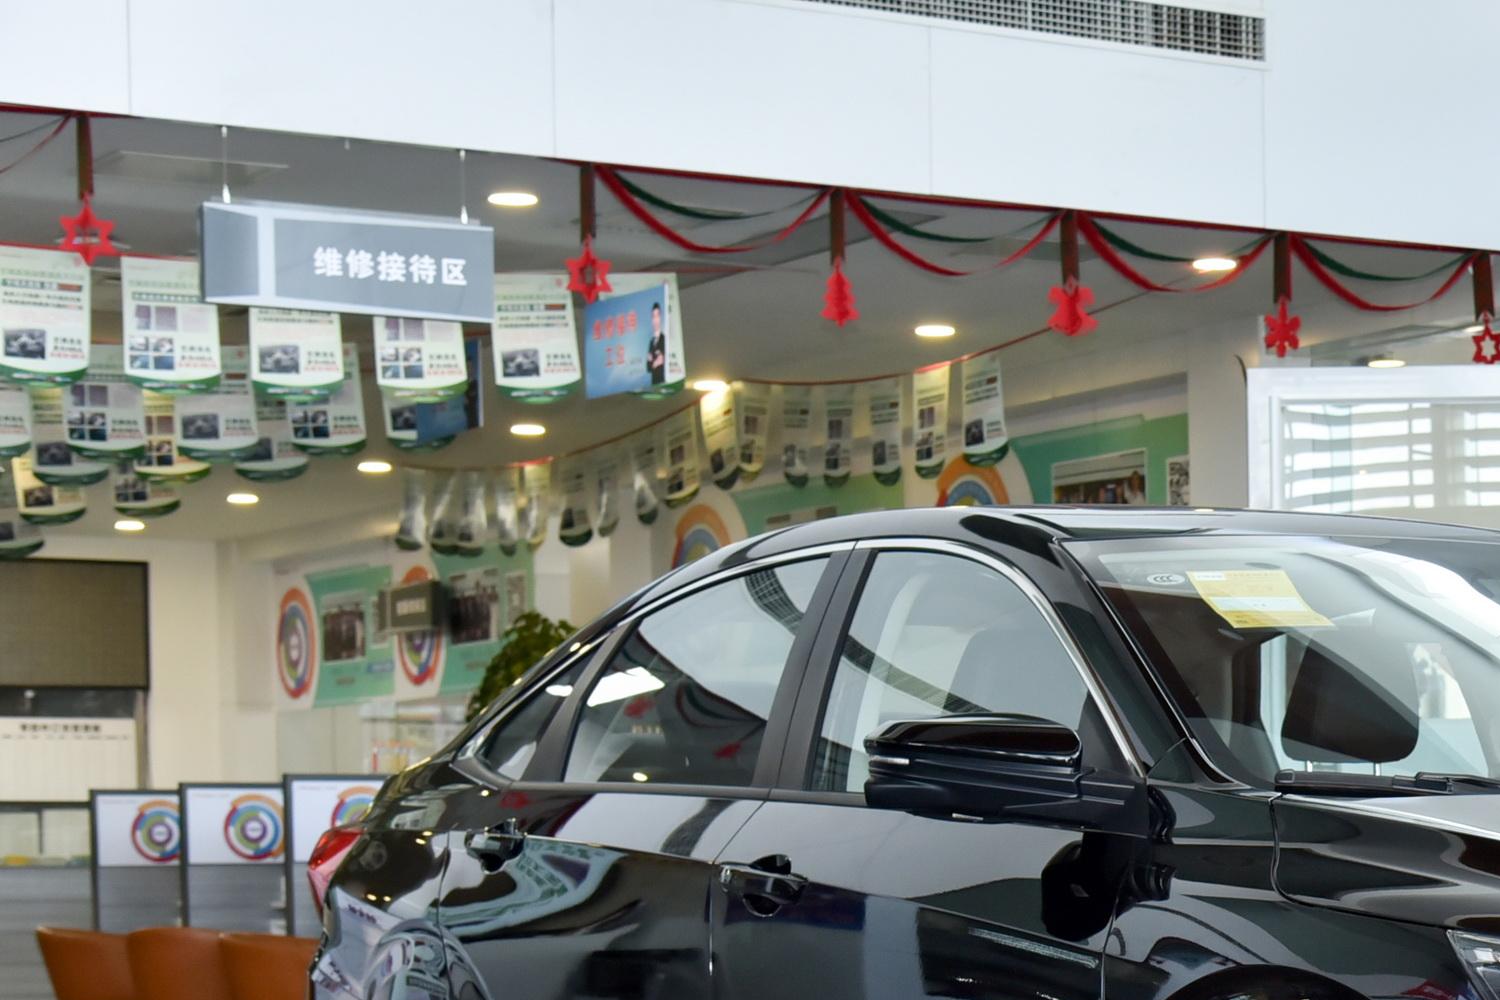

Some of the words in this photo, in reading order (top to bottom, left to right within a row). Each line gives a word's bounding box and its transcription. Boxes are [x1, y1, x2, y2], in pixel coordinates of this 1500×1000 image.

[313, 246, 468, 286] 维修接待区
